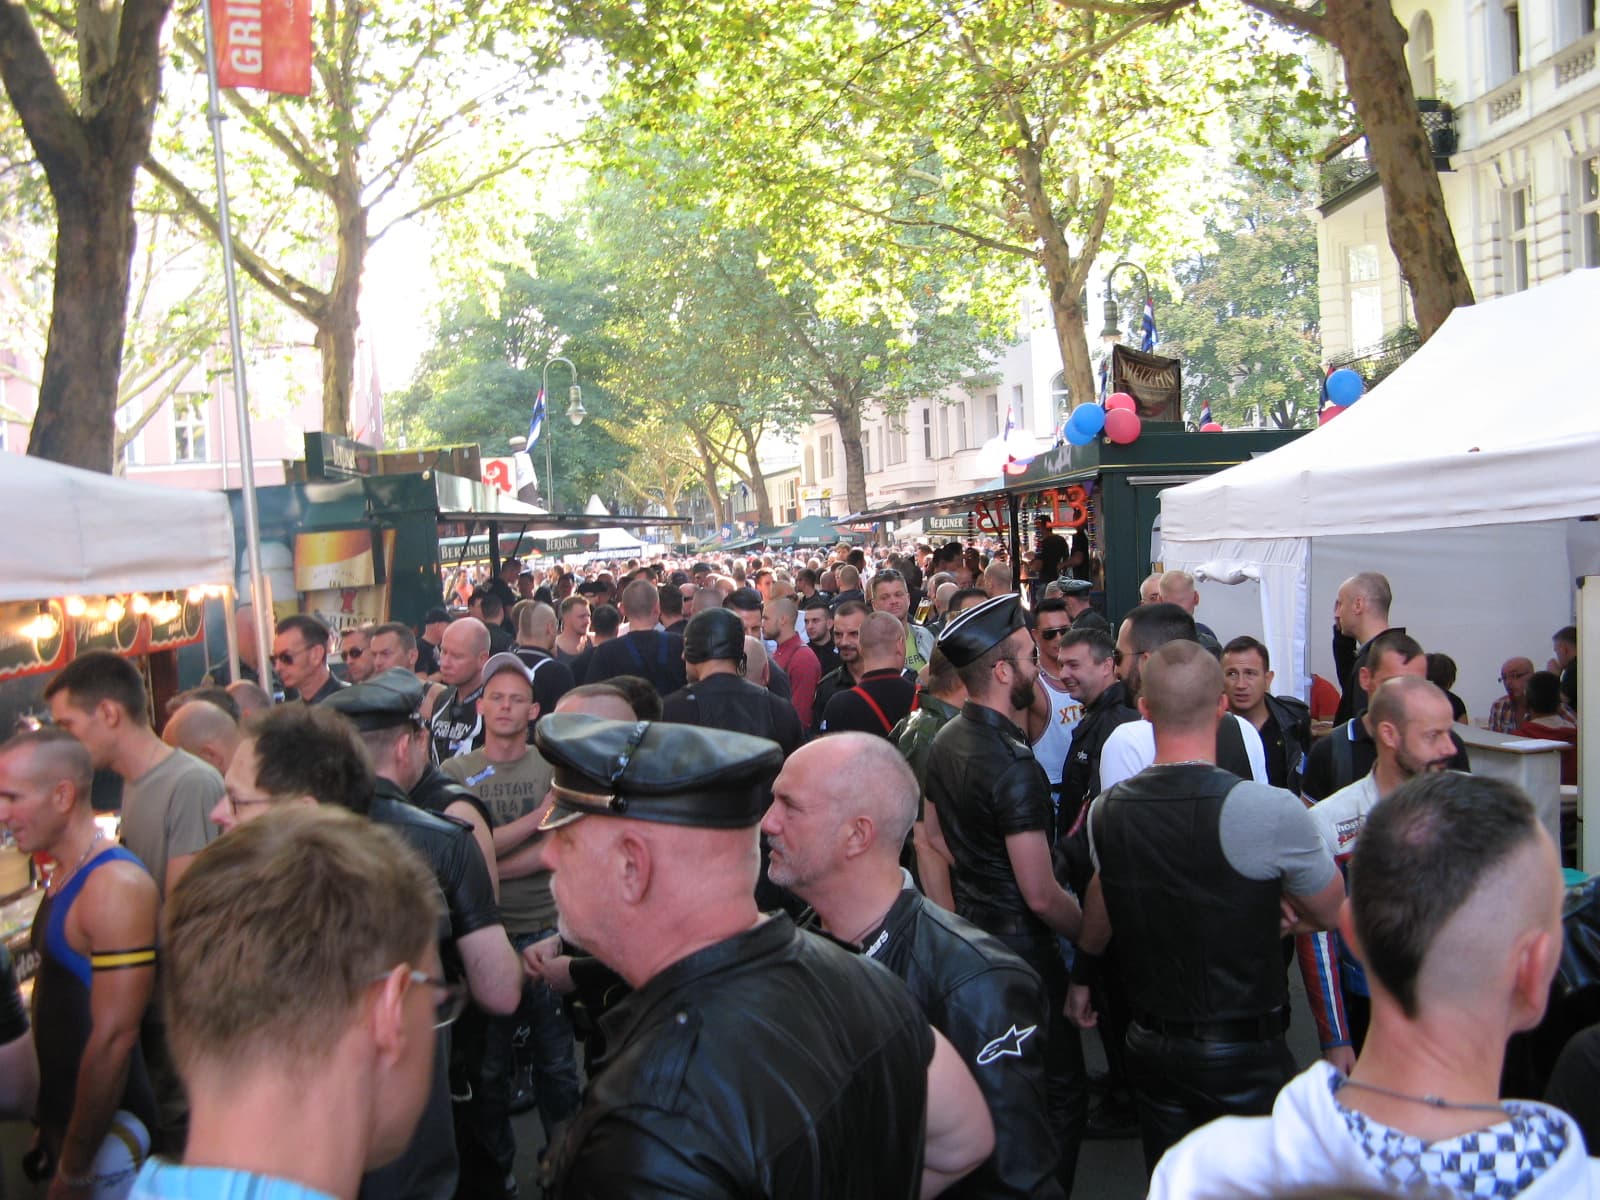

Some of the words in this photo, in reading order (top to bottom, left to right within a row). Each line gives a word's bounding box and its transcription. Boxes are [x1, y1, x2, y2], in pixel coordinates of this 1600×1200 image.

[226, 0, 263, 74] GRI
[930, 516, 964, 529] BERLINER
[545, 536, 578, 552] BERLINER
